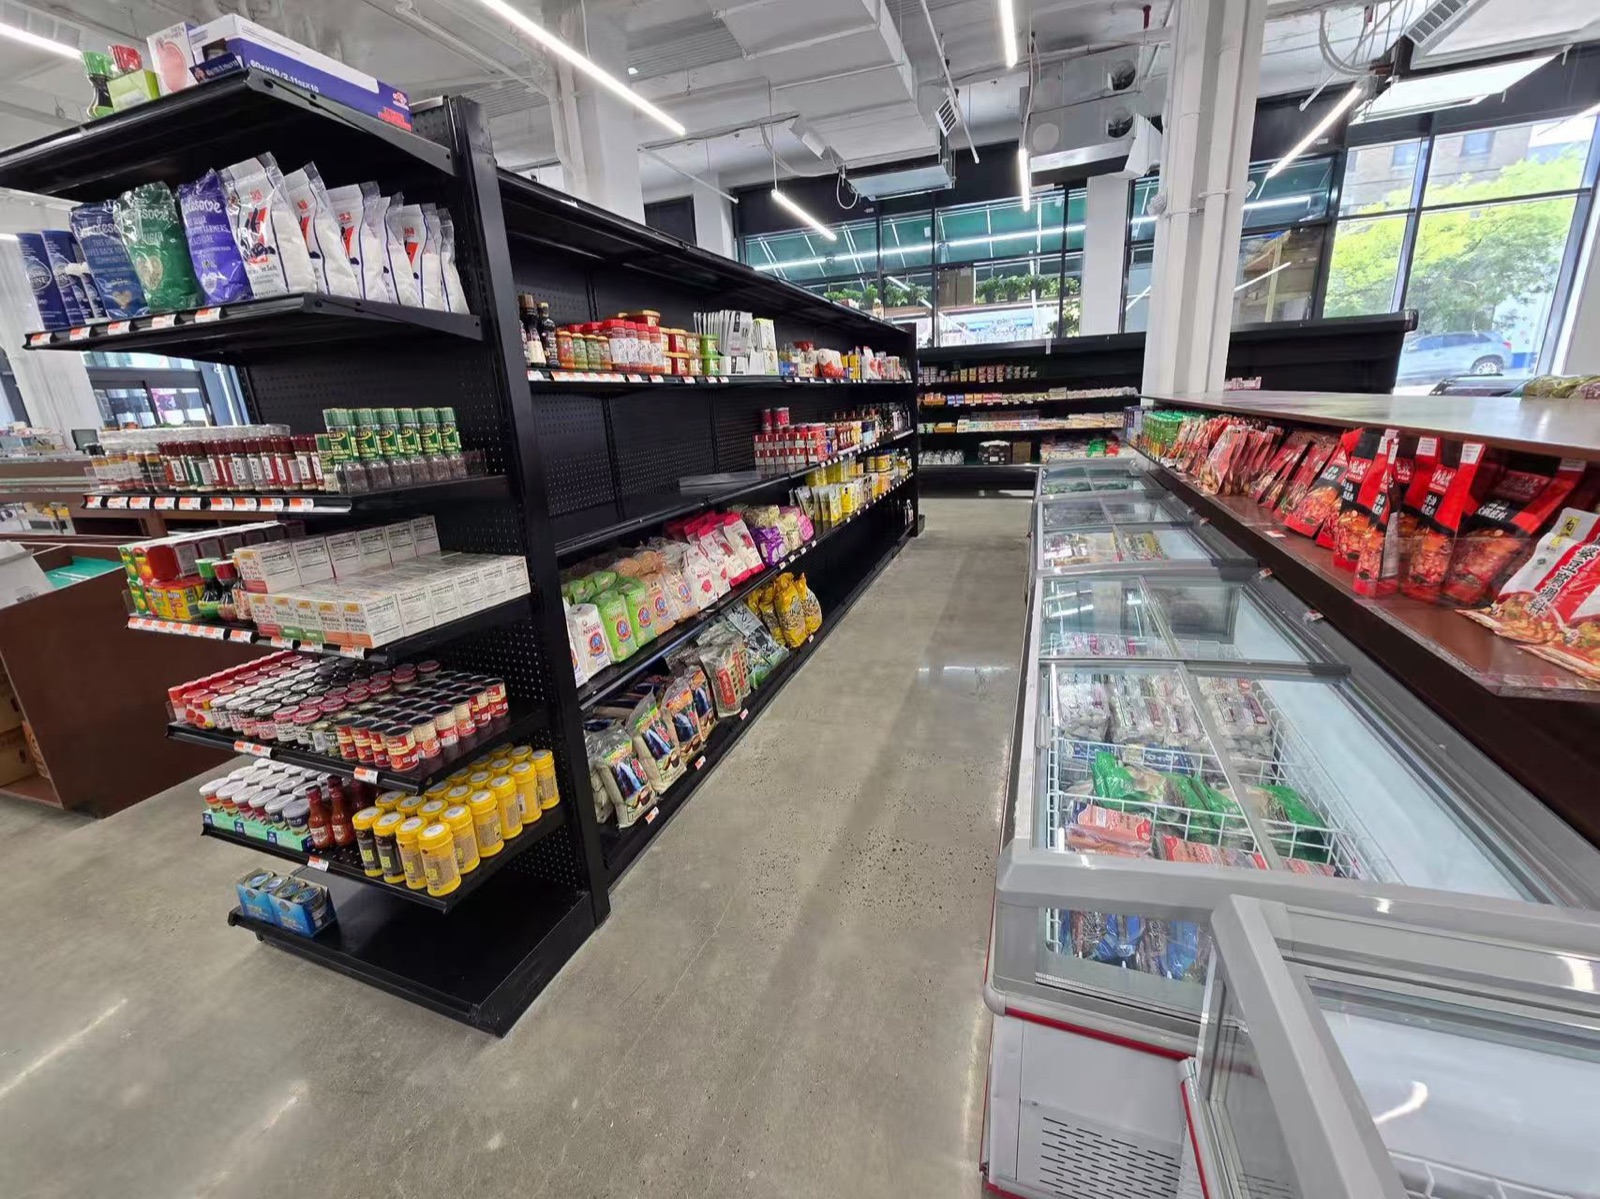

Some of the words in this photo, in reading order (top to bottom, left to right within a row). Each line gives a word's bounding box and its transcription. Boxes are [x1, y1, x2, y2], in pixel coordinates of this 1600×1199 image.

[1526, 534, 1600, 617] 婆豆腐调料
